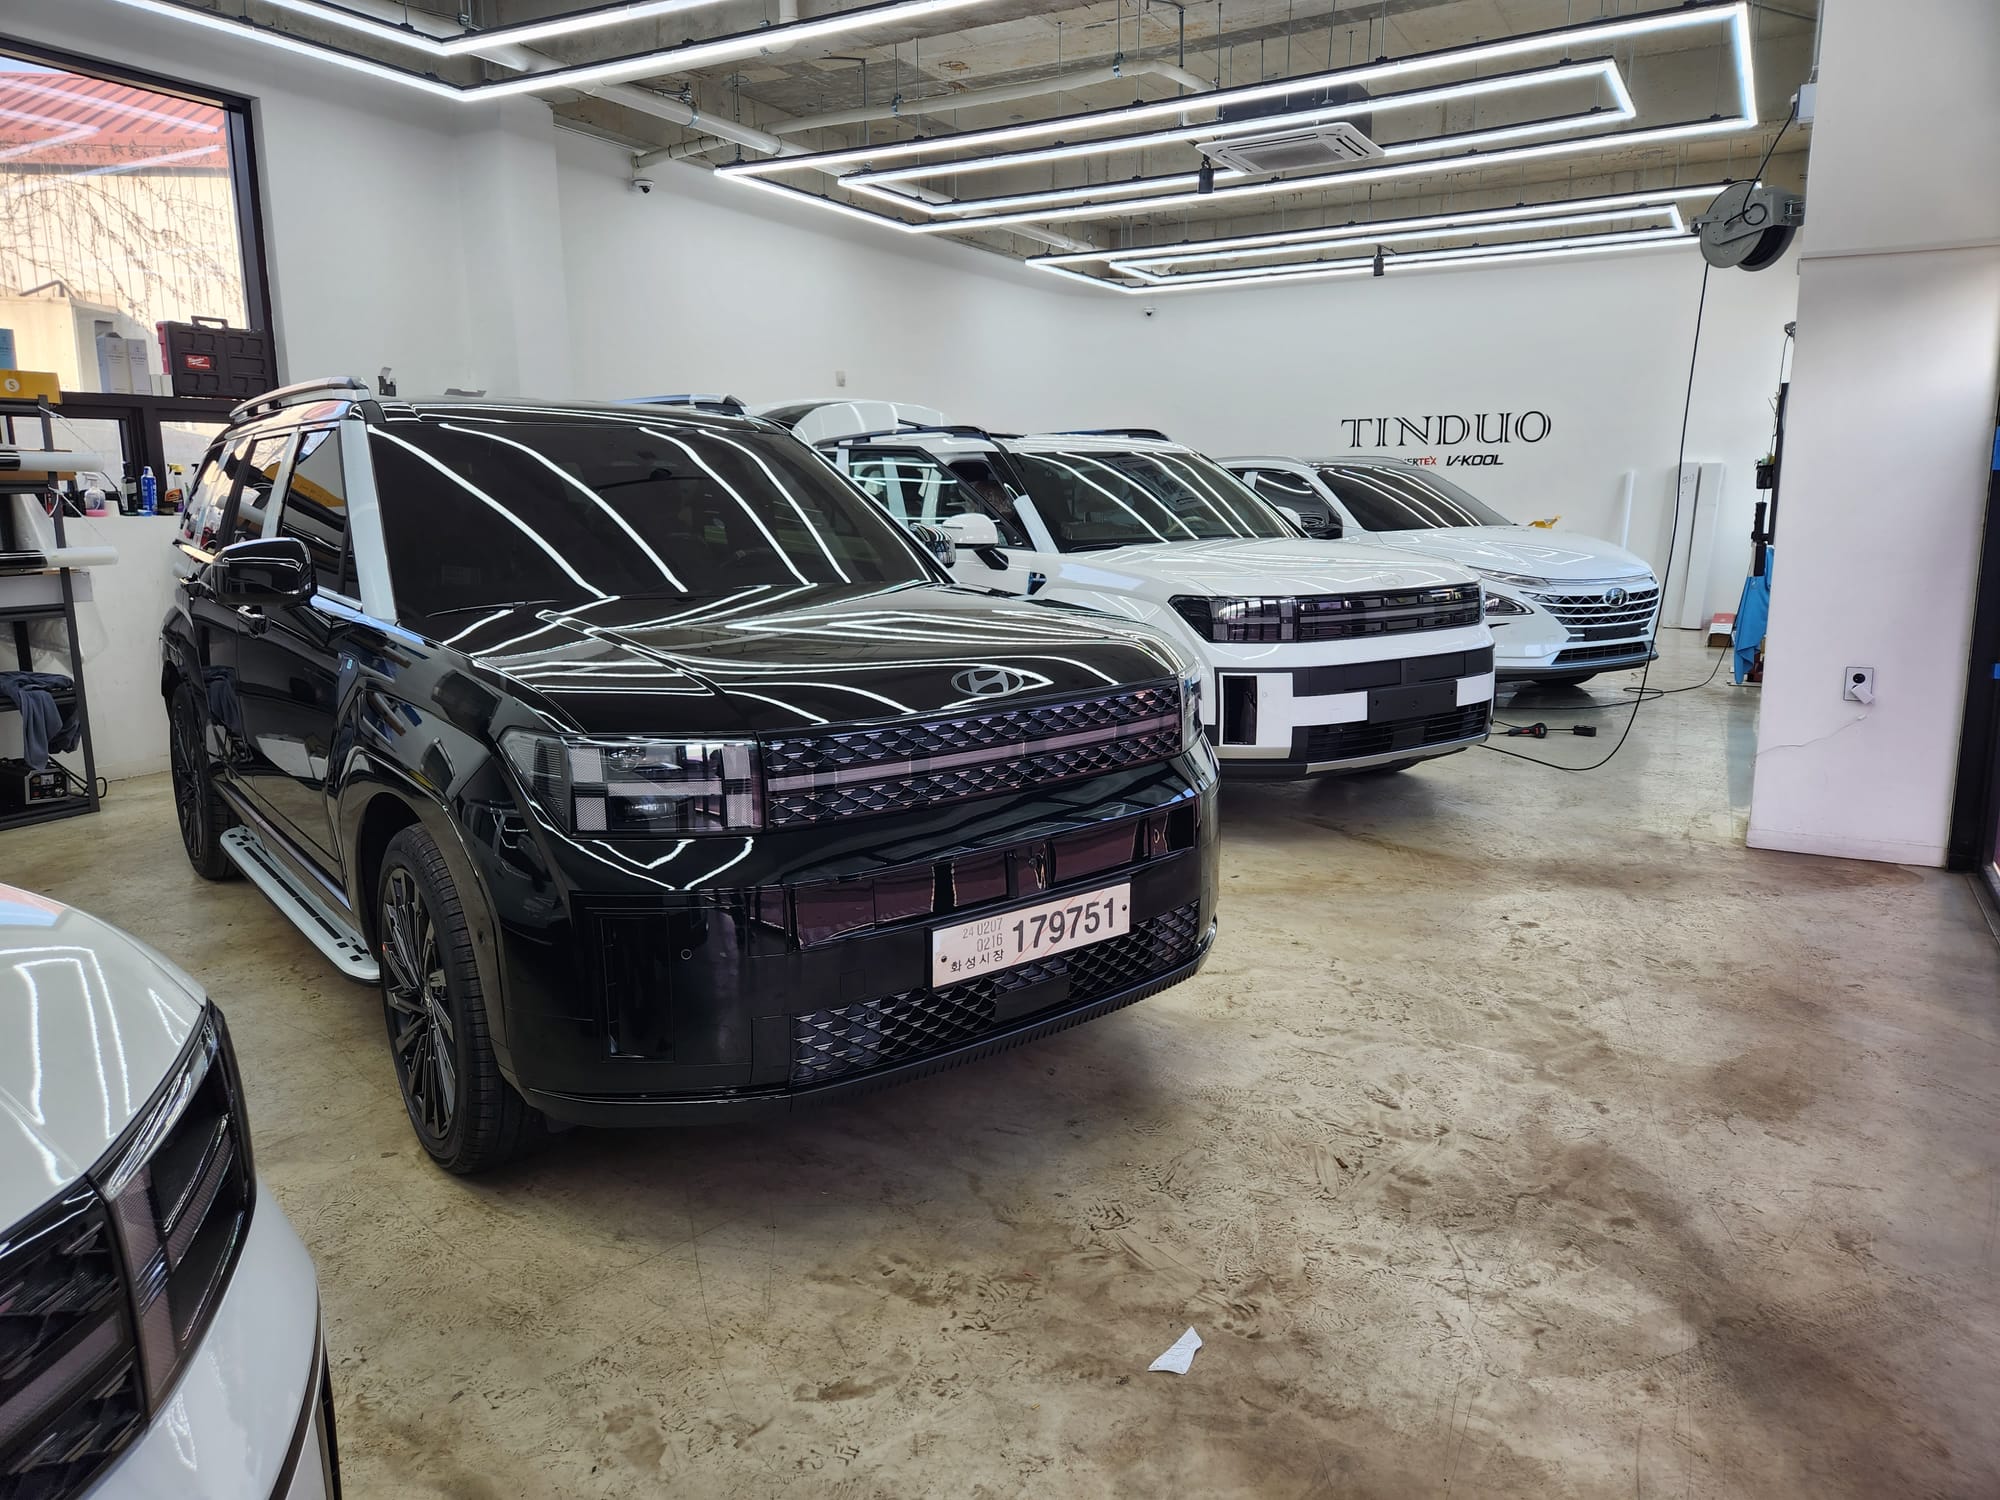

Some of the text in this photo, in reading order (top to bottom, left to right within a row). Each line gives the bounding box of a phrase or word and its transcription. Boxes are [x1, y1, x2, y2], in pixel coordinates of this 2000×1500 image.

[1341, 410, 1552, 448] TINDUO
[1404, 454, 1504, 466] ERTEX V-KOOL
[962, 917, 1003, 939] 24 0207
[1013, 897, 1114, 953] 179751
[977, 933, 1003, 953] 0216
